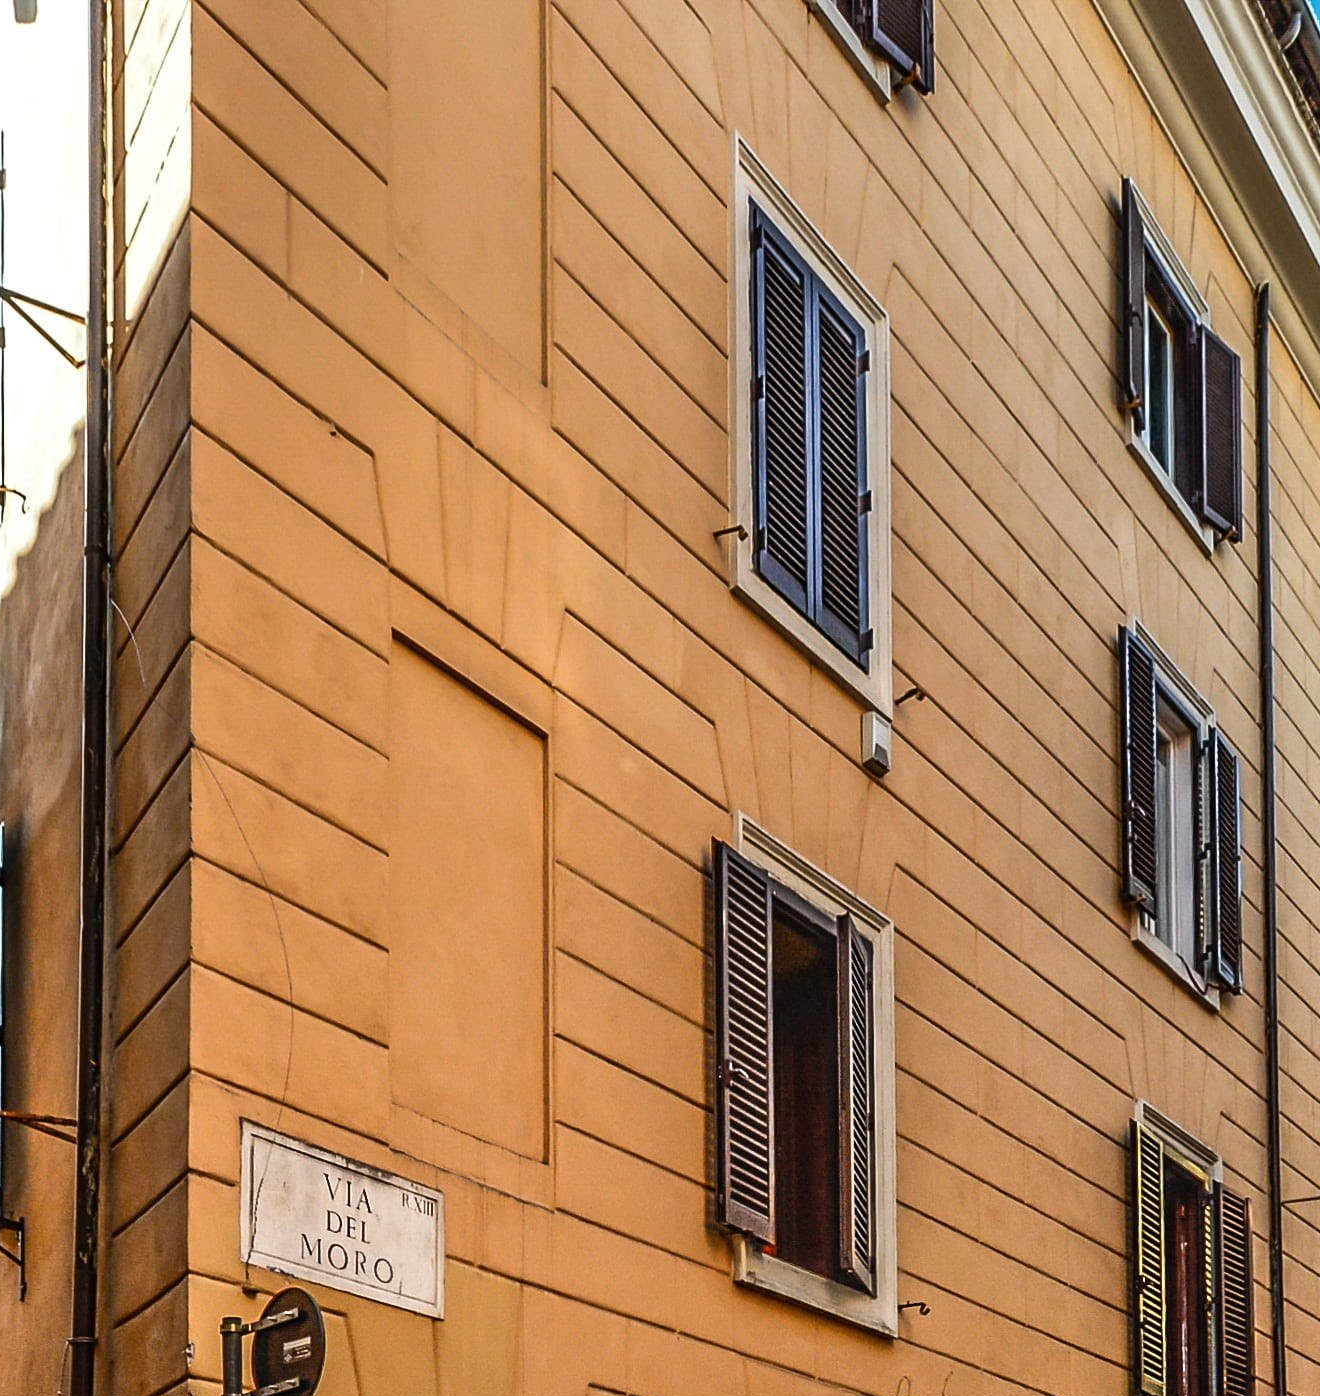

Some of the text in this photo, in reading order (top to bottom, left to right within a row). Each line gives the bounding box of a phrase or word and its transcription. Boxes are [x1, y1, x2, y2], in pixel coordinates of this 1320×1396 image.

[323, 1173, 373, 1214] VIA
[326, 1210, 371, 1244] DEL
[300, 1233, 394, 1284] MORO
